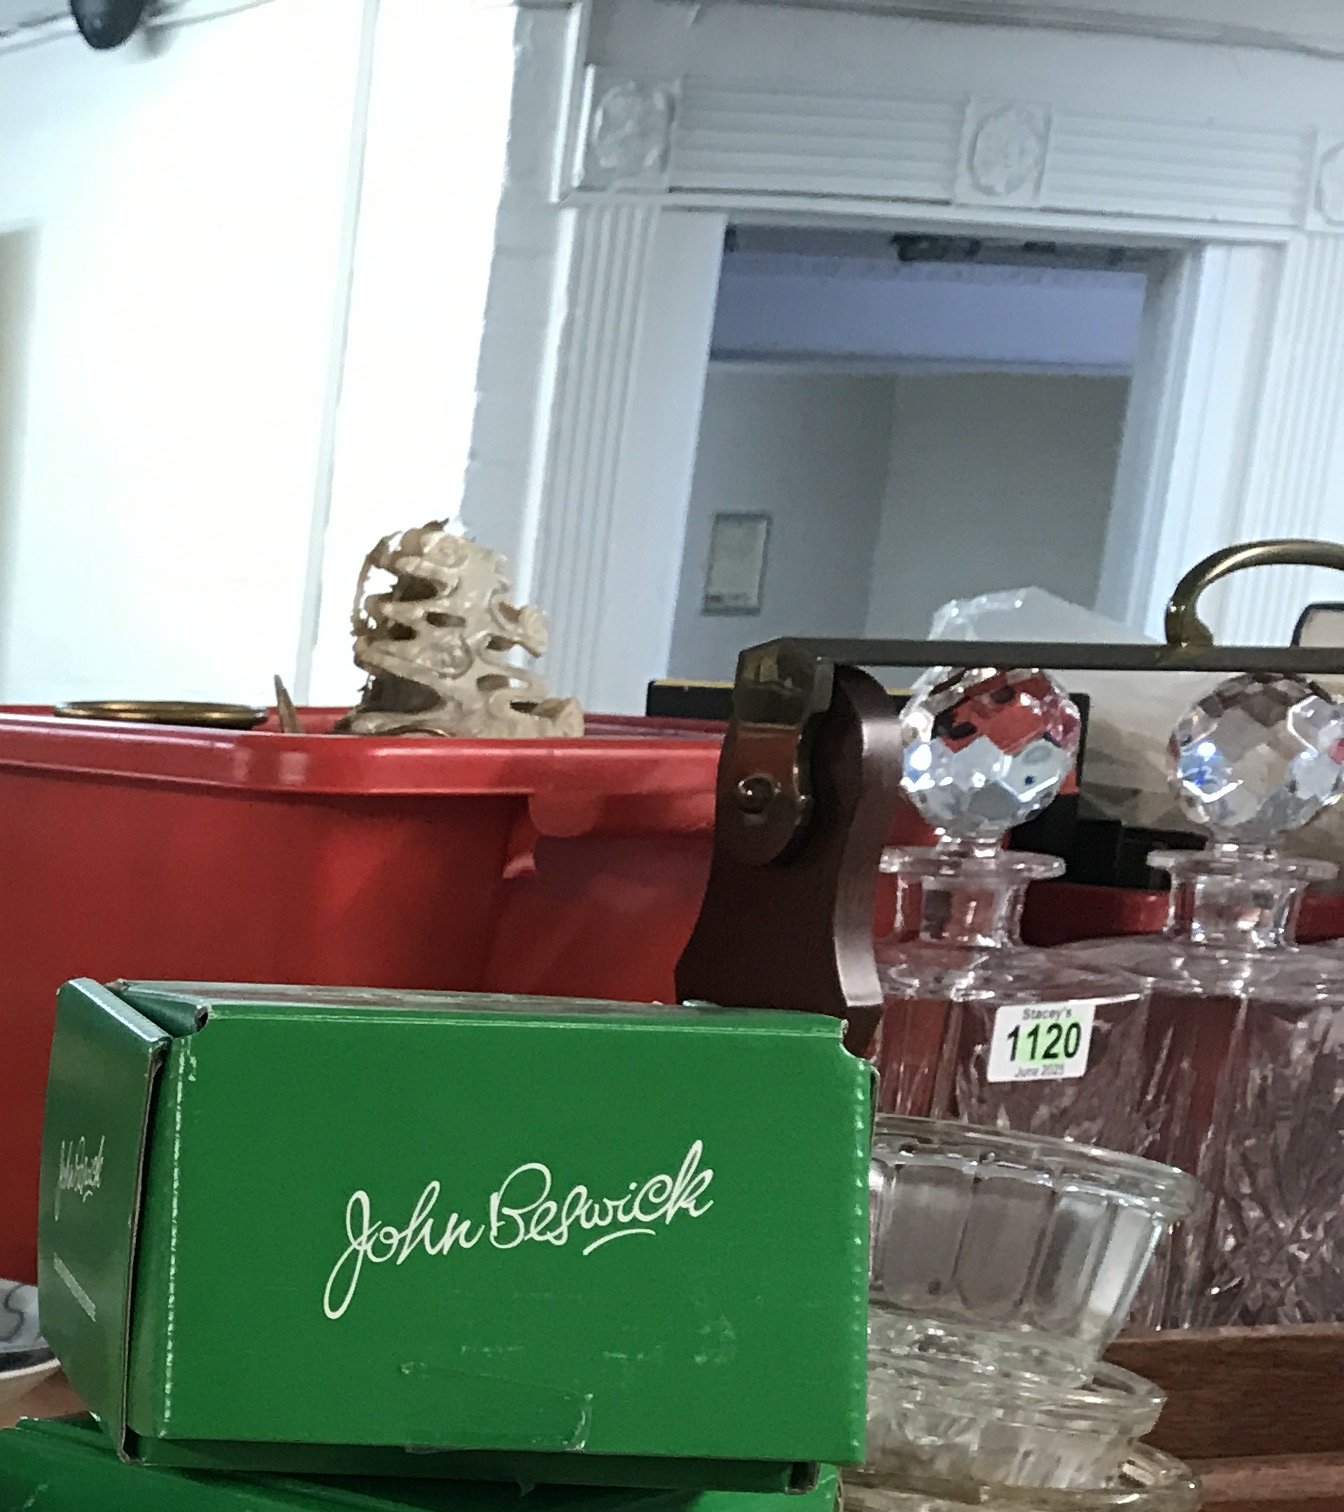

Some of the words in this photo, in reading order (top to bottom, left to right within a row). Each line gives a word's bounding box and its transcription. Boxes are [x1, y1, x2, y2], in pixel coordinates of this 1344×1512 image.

[1022, 1006, 1072, 1021] Stacey's
[1006, 1021, 1082, 1062] 1120
[323, 1180, 485, 1320] John
[489, 1139, 714, 1255] Beswick
